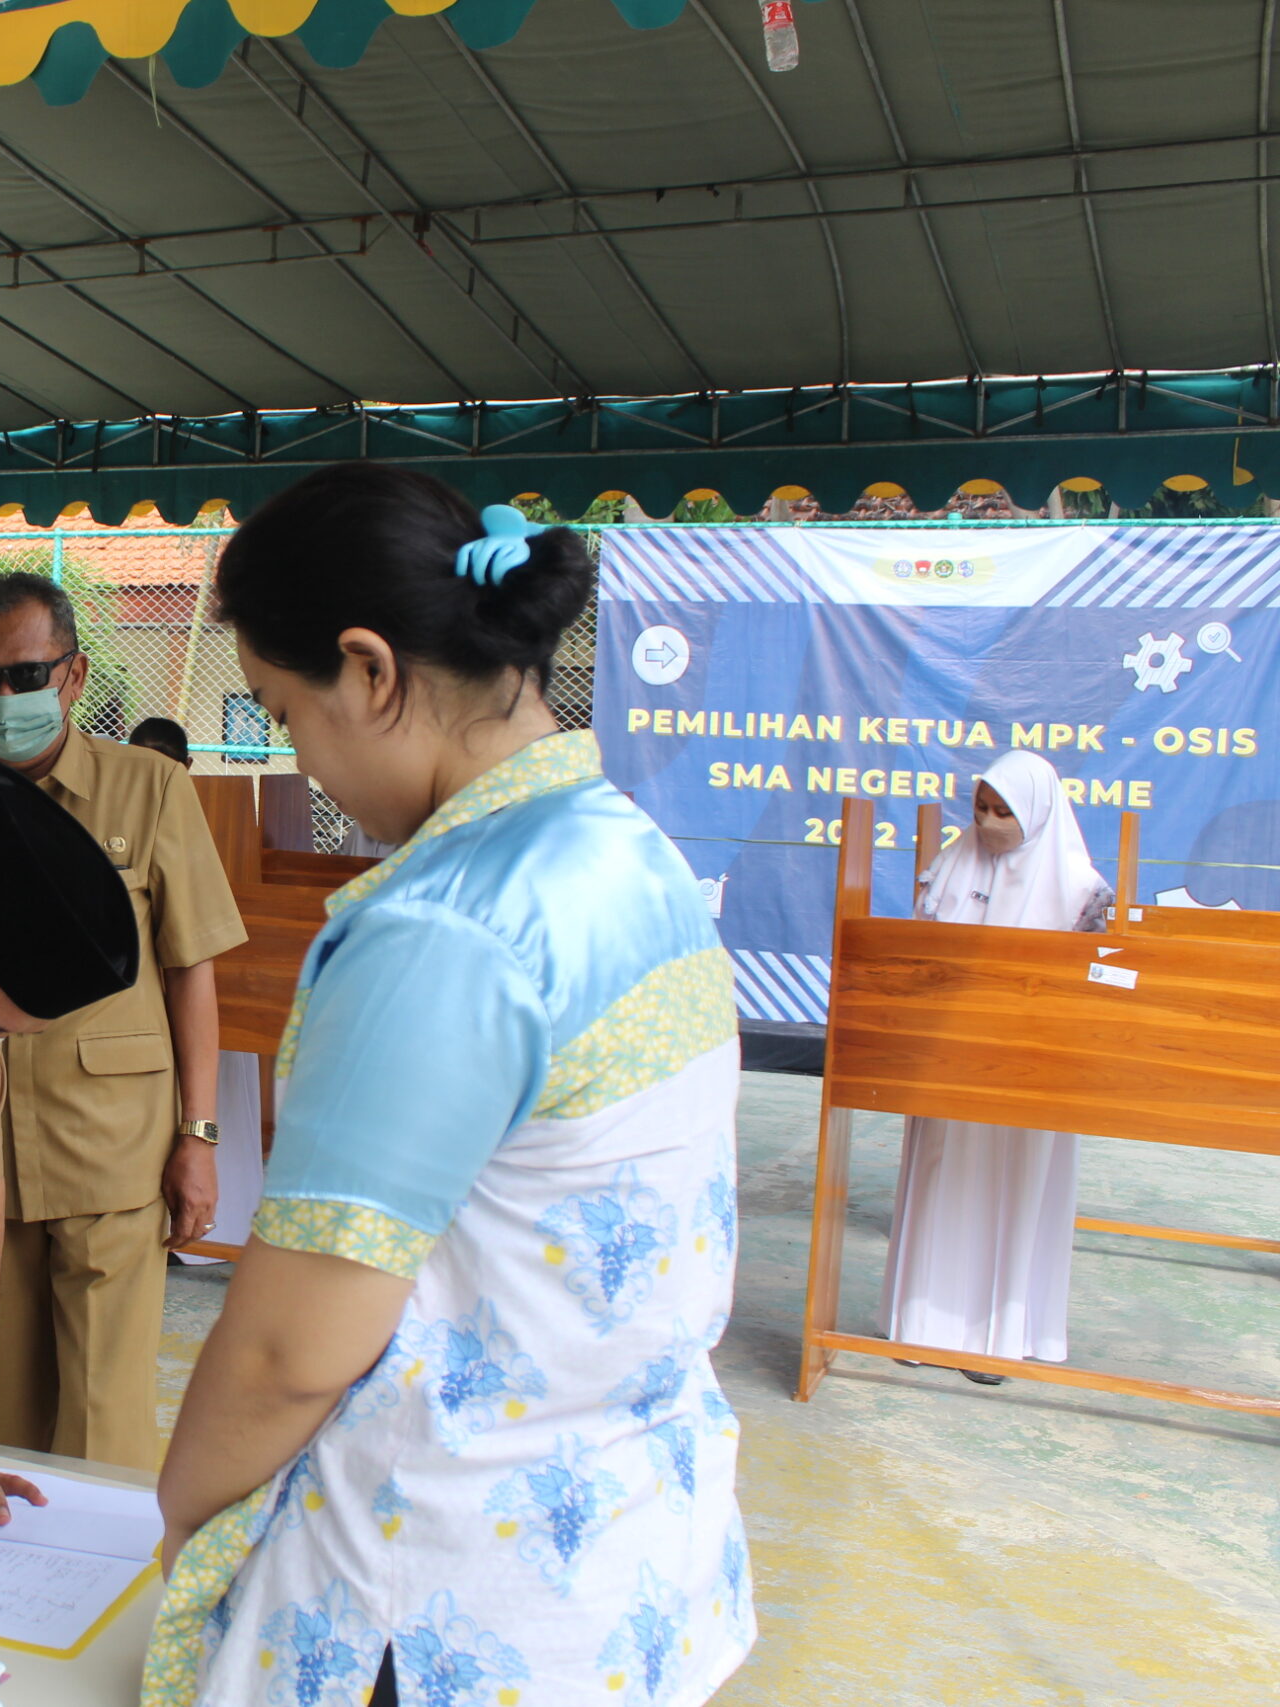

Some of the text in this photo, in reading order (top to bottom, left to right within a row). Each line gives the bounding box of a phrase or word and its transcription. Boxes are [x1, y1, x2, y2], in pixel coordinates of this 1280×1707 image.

[627, 708, 842, 741] PEMILIHAN
[858, 716, 996, 748] KETUA
[1010, 722, 1107, 751] MPK
[1153, 726, 1258, 756] OSIS
[707, 761, 792, 791] SMA
[806, 766, 956, 799] NEGERI
[803, 817, 897, 848] 202
